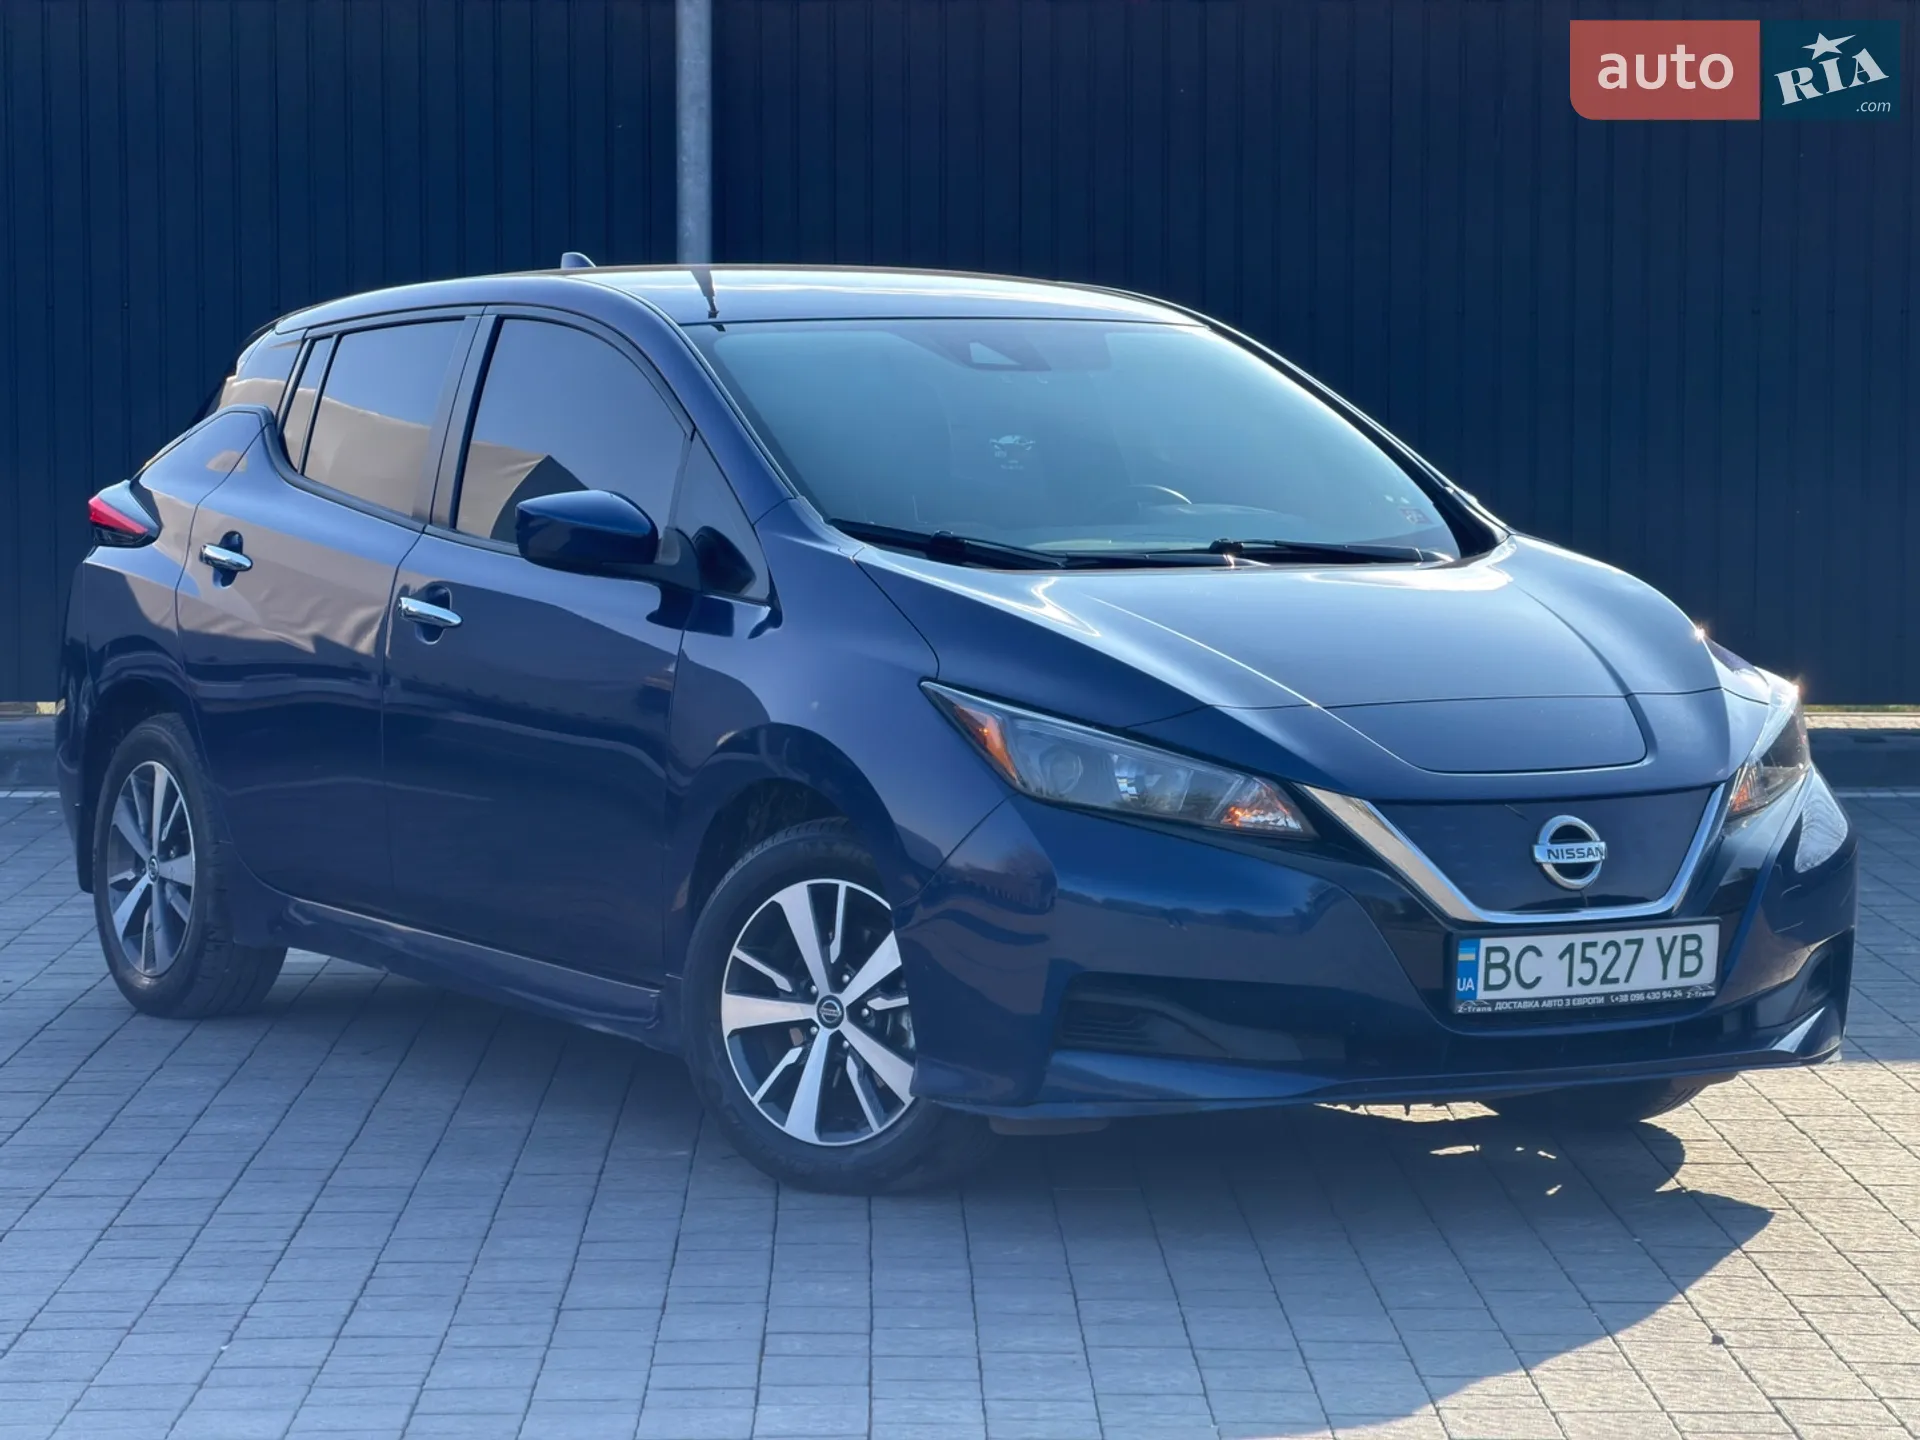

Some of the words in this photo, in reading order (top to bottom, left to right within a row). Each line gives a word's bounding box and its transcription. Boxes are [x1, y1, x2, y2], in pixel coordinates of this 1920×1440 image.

[1546, 846, 1604, 860] NISSAN
[1483, 944, 1544, 992] BC
[1558, 937, 1644, 988] 1527
[1656, 933, 1704, 980] YB
[1456, 976, 1475, 992] UA
[1646, 991, 1661, 1000] 430
[1662, 990, 1672, 999] 94
[1494, 1000, 1540, 1011] ДОСТАВКА
[1541, 999, 1564, 1009] АВТО
[1572, 996, 1604, 1007] ЄВРОПИ
